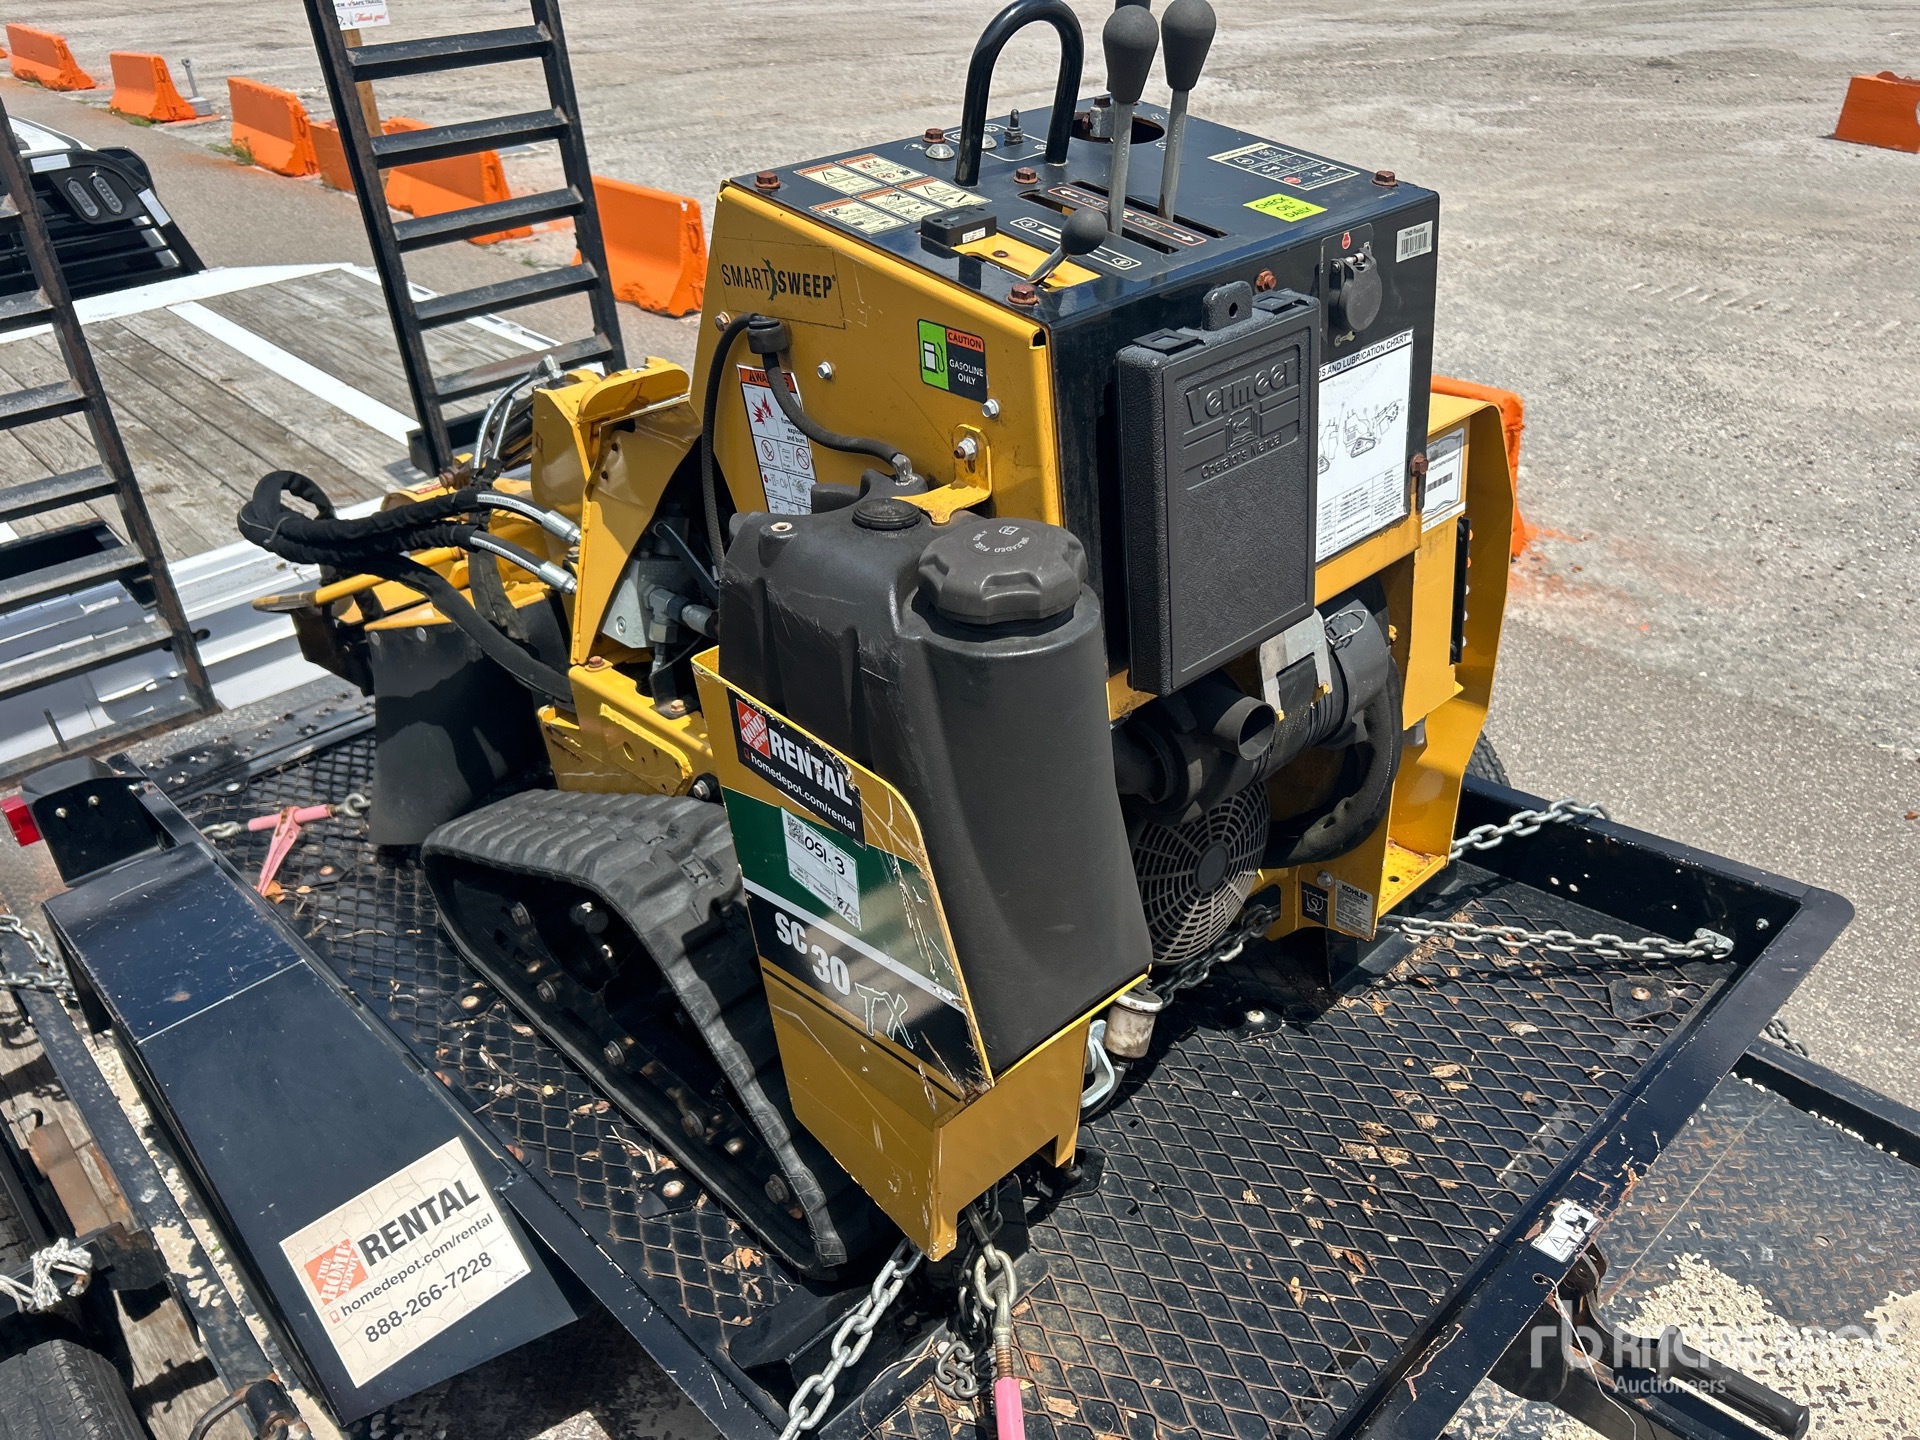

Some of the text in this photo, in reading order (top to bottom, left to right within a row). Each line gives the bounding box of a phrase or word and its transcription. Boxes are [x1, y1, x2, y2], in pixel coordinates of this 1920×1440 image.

[1255, 196, 1285, 209] CHECK
[1284, 206, 1312, 218] DAILY
[721, 263, 770, 291] SMART
[948, 332, 981, 350] CAUTION
[1327, 361, 1342, 375] AND
[1343, 344, 1385, 368] LUBRICATION
[1386, 334, 1408, 350] CHART
[949, 359, 984, 377] GASOLINE
[957, 373, 976, 385] ONLY
[1186, 357, 1296, 426] Vermeer
[1201, 431, 1282, 479] Operator's Manual
[741, 714, 766, 745] HOME
[769, 727, 853, 806] RENTAL
[751, 752, 856, 832] homedepot.com/rental
[1342, 884, 1368, 900] KOHLER
[774, 912, 914, 1049] SC 30 TX
[357, 1179, 481, 1267] RENTAL
[315, 1257, 332, 1281] THE
[321, 1243, 351, 1302] HOME
[340, 1212, 494, 1318] homedepot.com/rental
[340, 1256, 359, 1292] DEPOT
[365, 1251, 493, 1344] 888-266-7228
